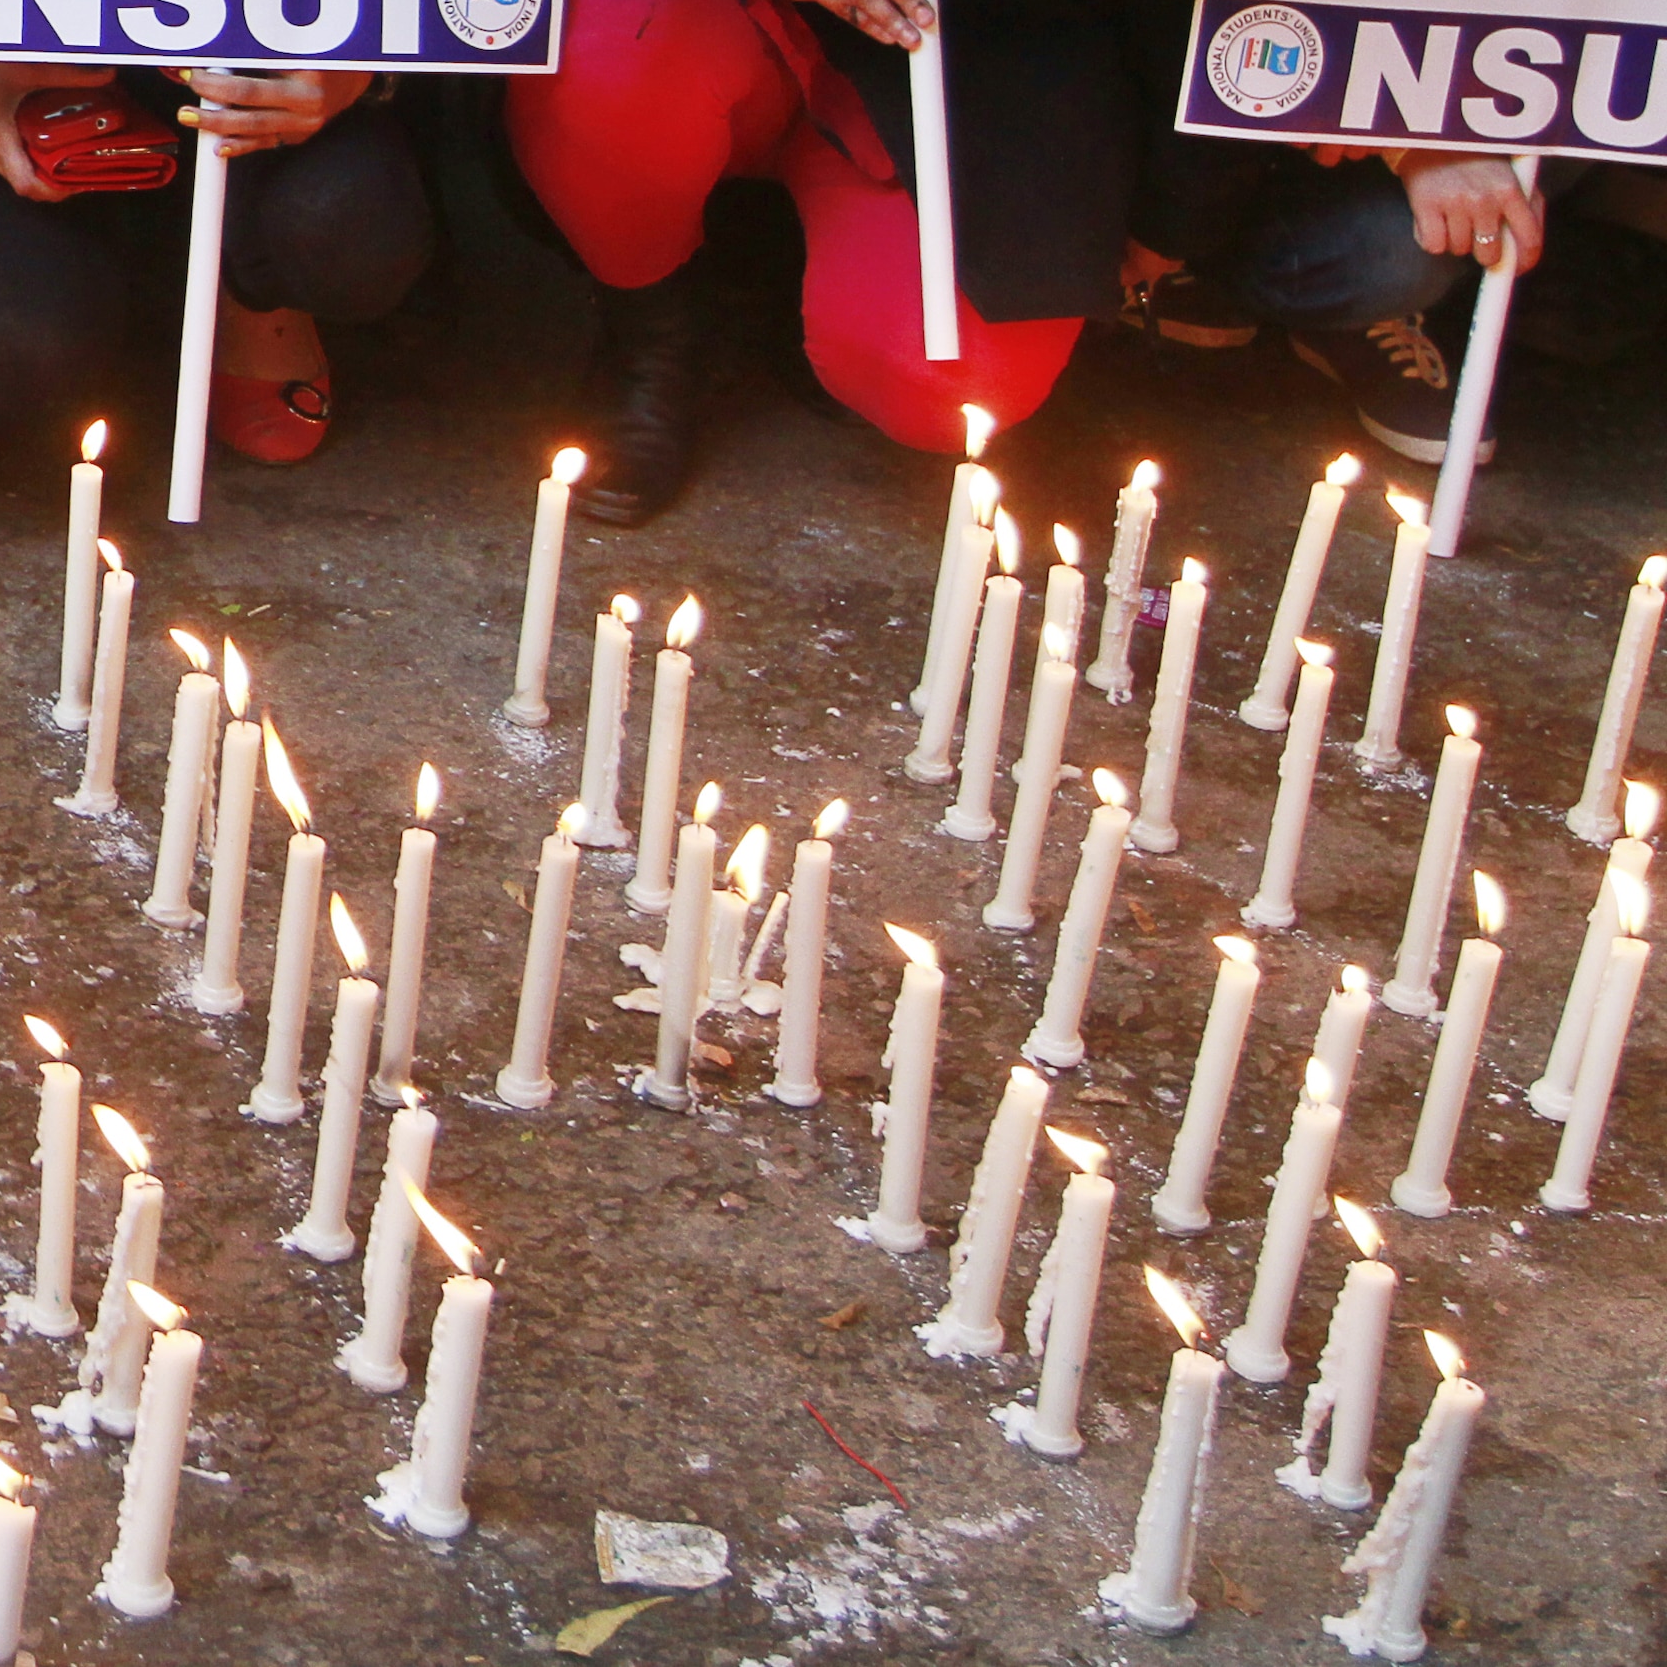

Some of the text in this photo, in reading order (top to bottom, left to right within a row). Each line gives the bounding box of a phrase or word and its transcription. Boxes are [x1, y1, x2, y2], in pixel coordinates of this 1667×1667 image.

[1210, 7, 1320, 111] NATIONAL STUDENTS' UNION OF INDIA
